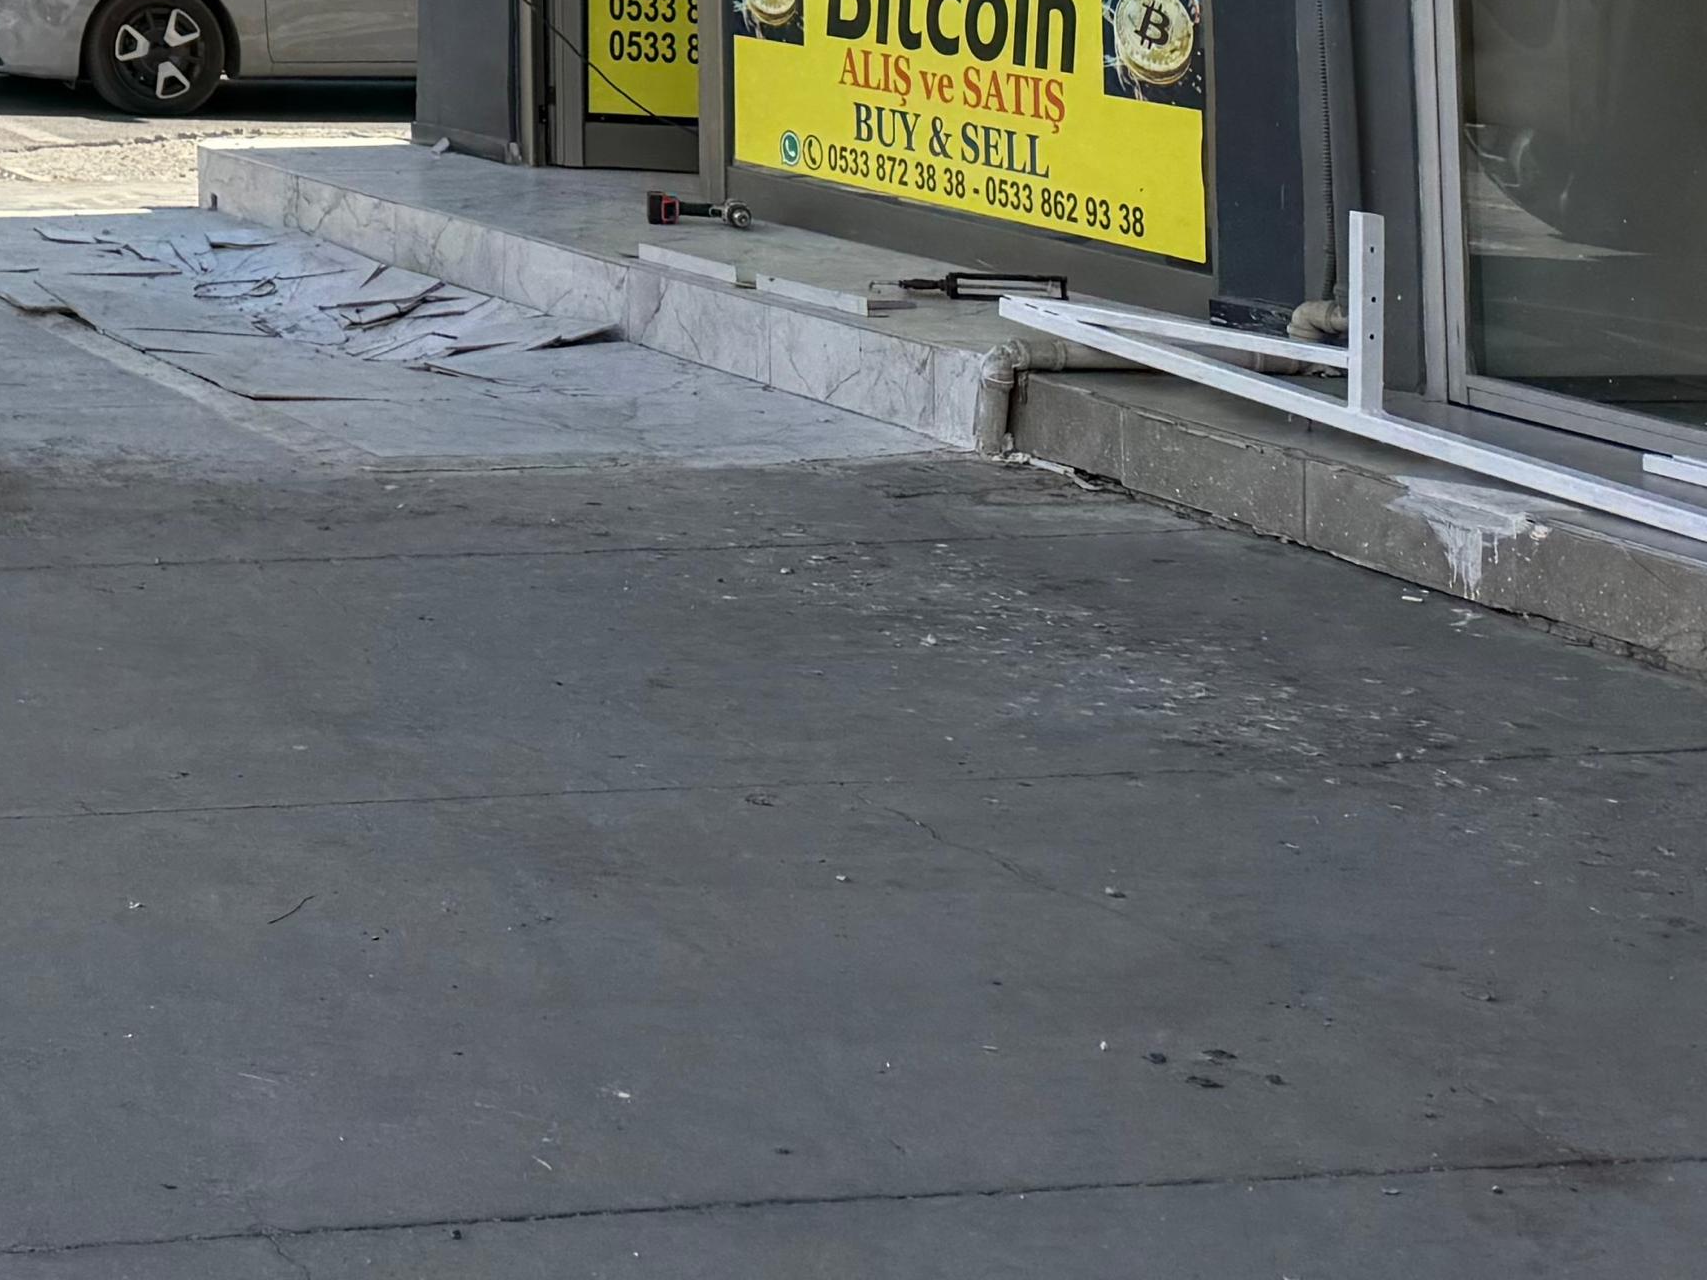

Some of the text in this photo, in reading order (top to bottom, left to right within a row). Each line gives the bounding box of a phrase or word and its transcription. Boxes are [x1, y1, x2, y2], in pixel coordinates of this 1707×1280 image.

[609, 30, 677, 64] 0533
[839, 46, 1066, 134] ALIŞ ve SATIŞ
[853, 101, 1051, 180] BUY & SELL
[828, 143, 870, 181] 0533
[875, 156, 909, 188] 872
[914, 160, 937, 193] 38
[943, 167, 966, 199] 38
[985, 176, 1034, 214] 0533
[1040, 188, 1078, 224] 862
[1085, 196, 1113, 231] 93
[1118, 203, 1146, 238] 38
